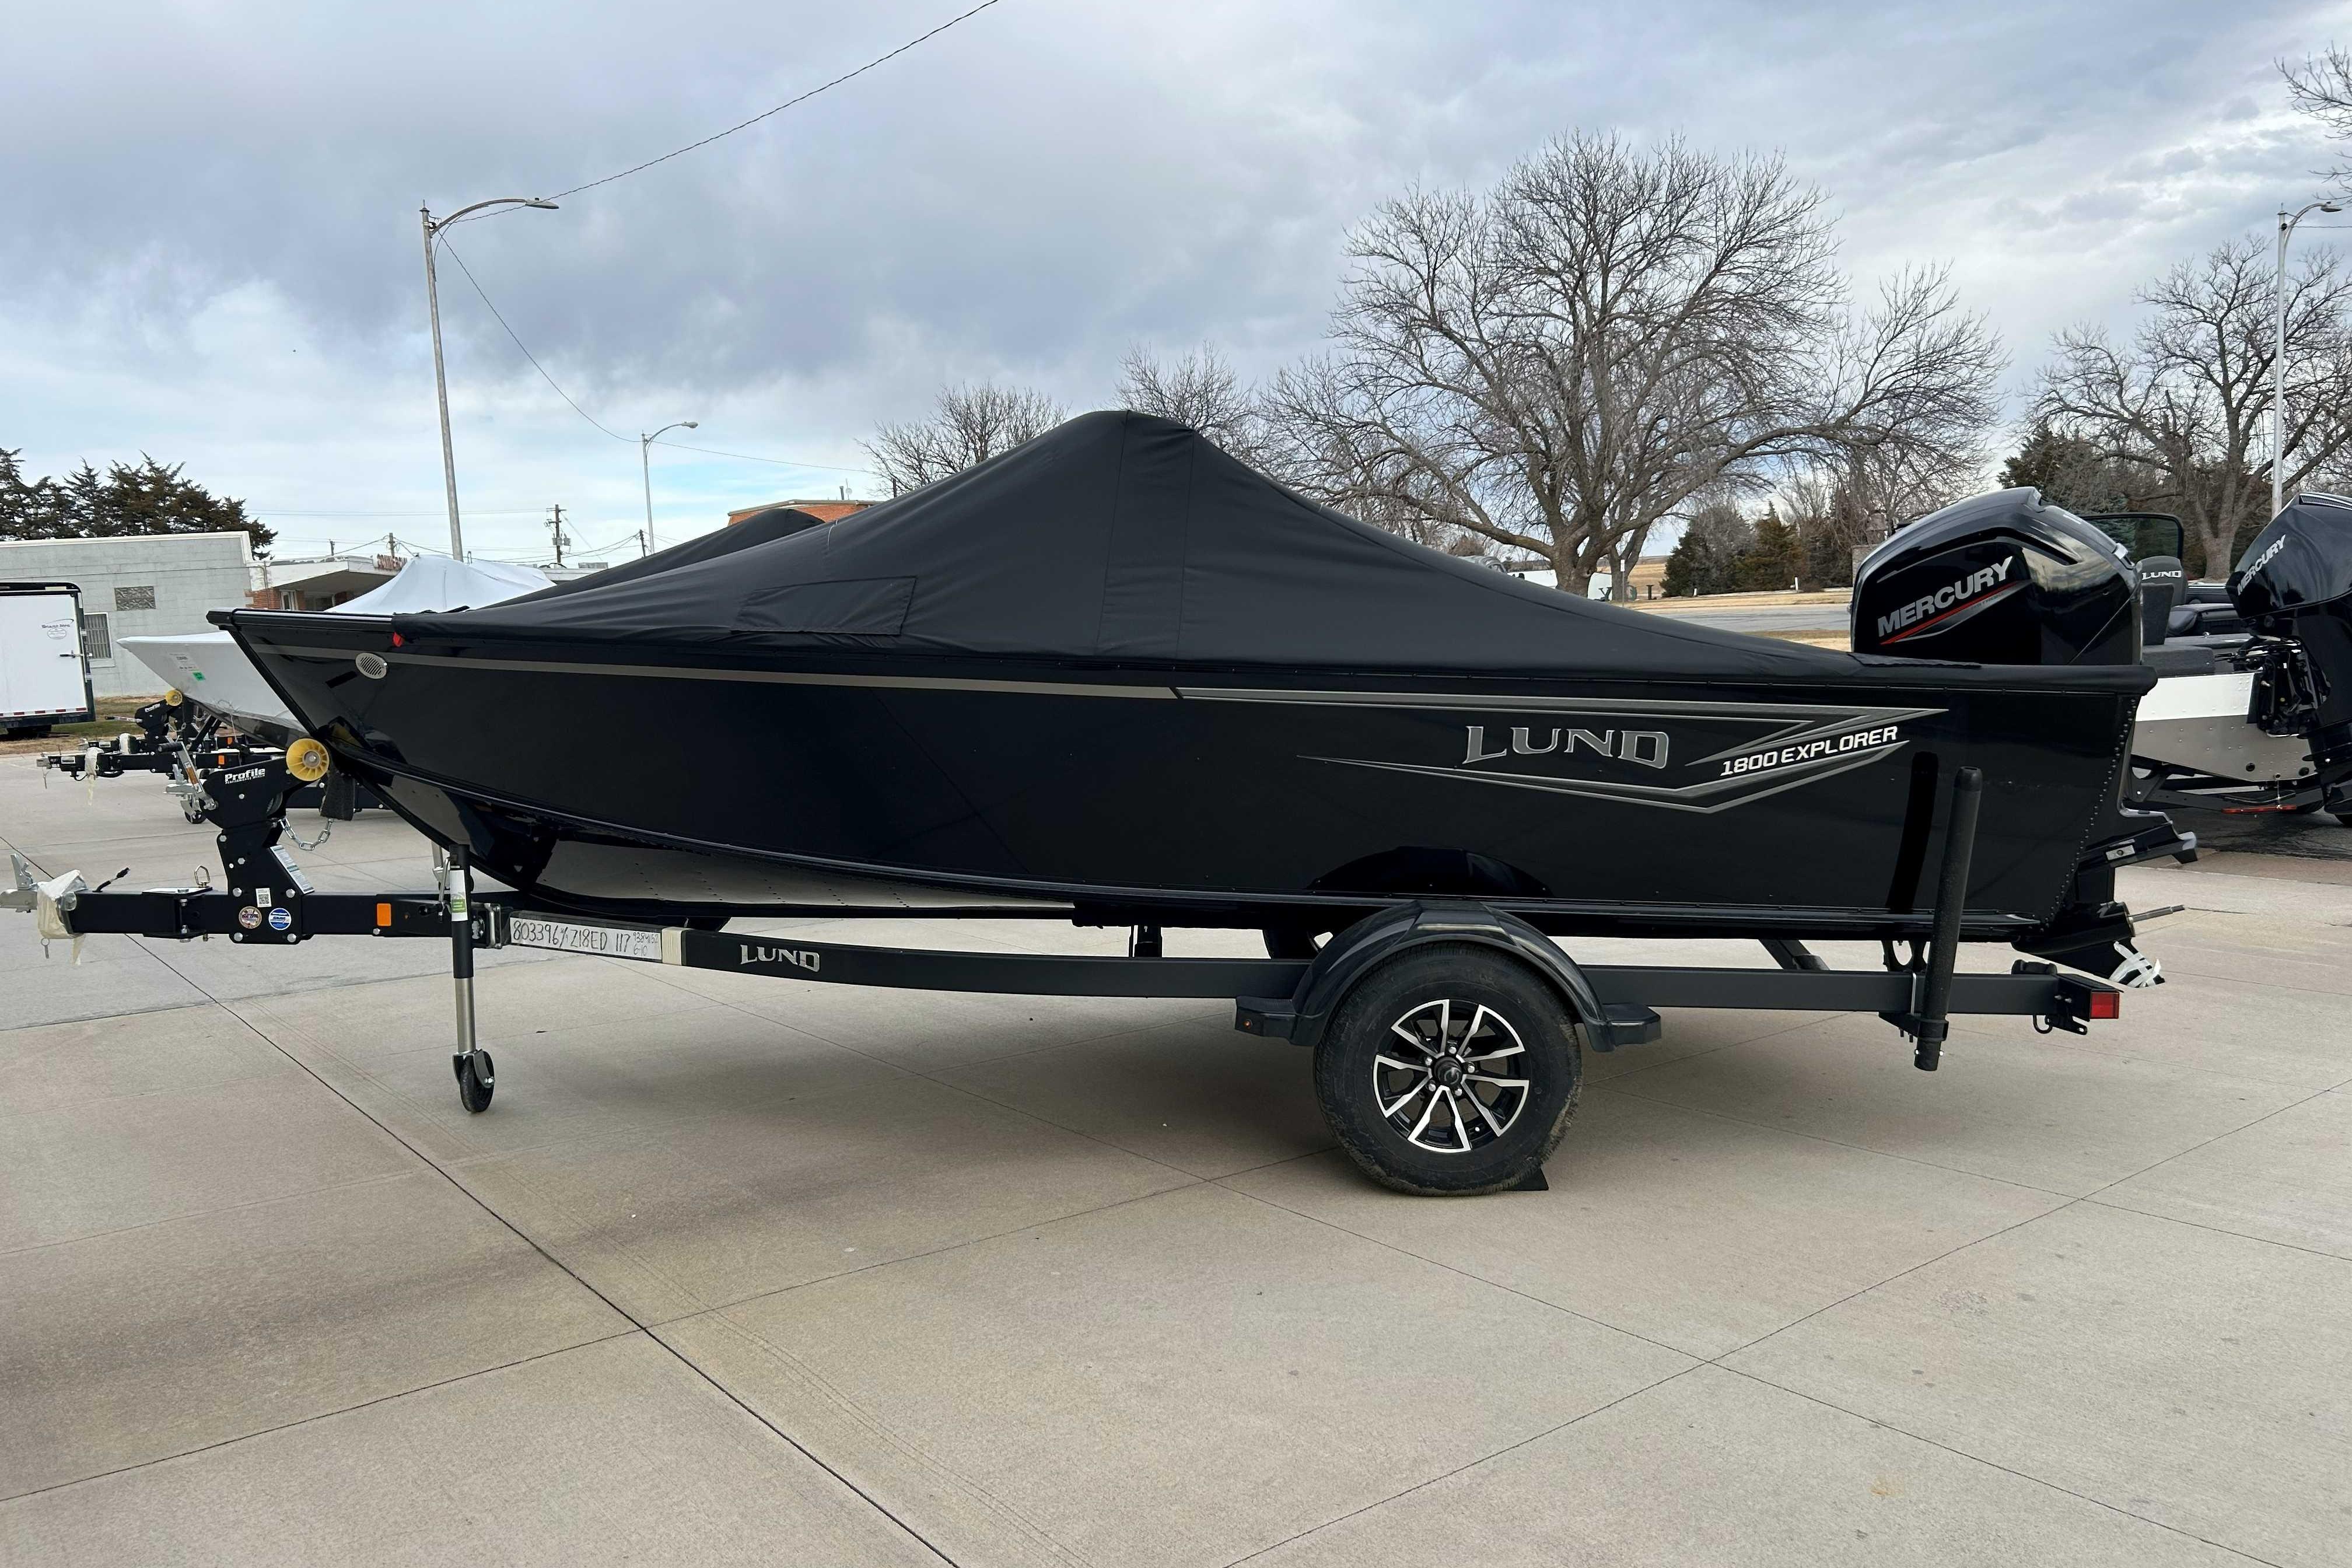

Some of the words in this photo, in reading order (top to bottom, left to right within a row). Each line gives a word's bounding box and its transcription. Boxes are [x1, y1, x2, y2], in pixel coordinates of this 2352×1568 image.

[2141, 570, 2182, 580] LUND
[2237, 534, 2286, 596] MERCURY
[1877, 555, 2013, 637] MERCURY
[1462, 726, 1669, 769] LUND
[1720, 751, 1778, 776] 1800
[1780, 726, 1898, 764] EXPLORER
[225, 768, 265, 782] Profile
[740, 944, 820, 972] LUND
